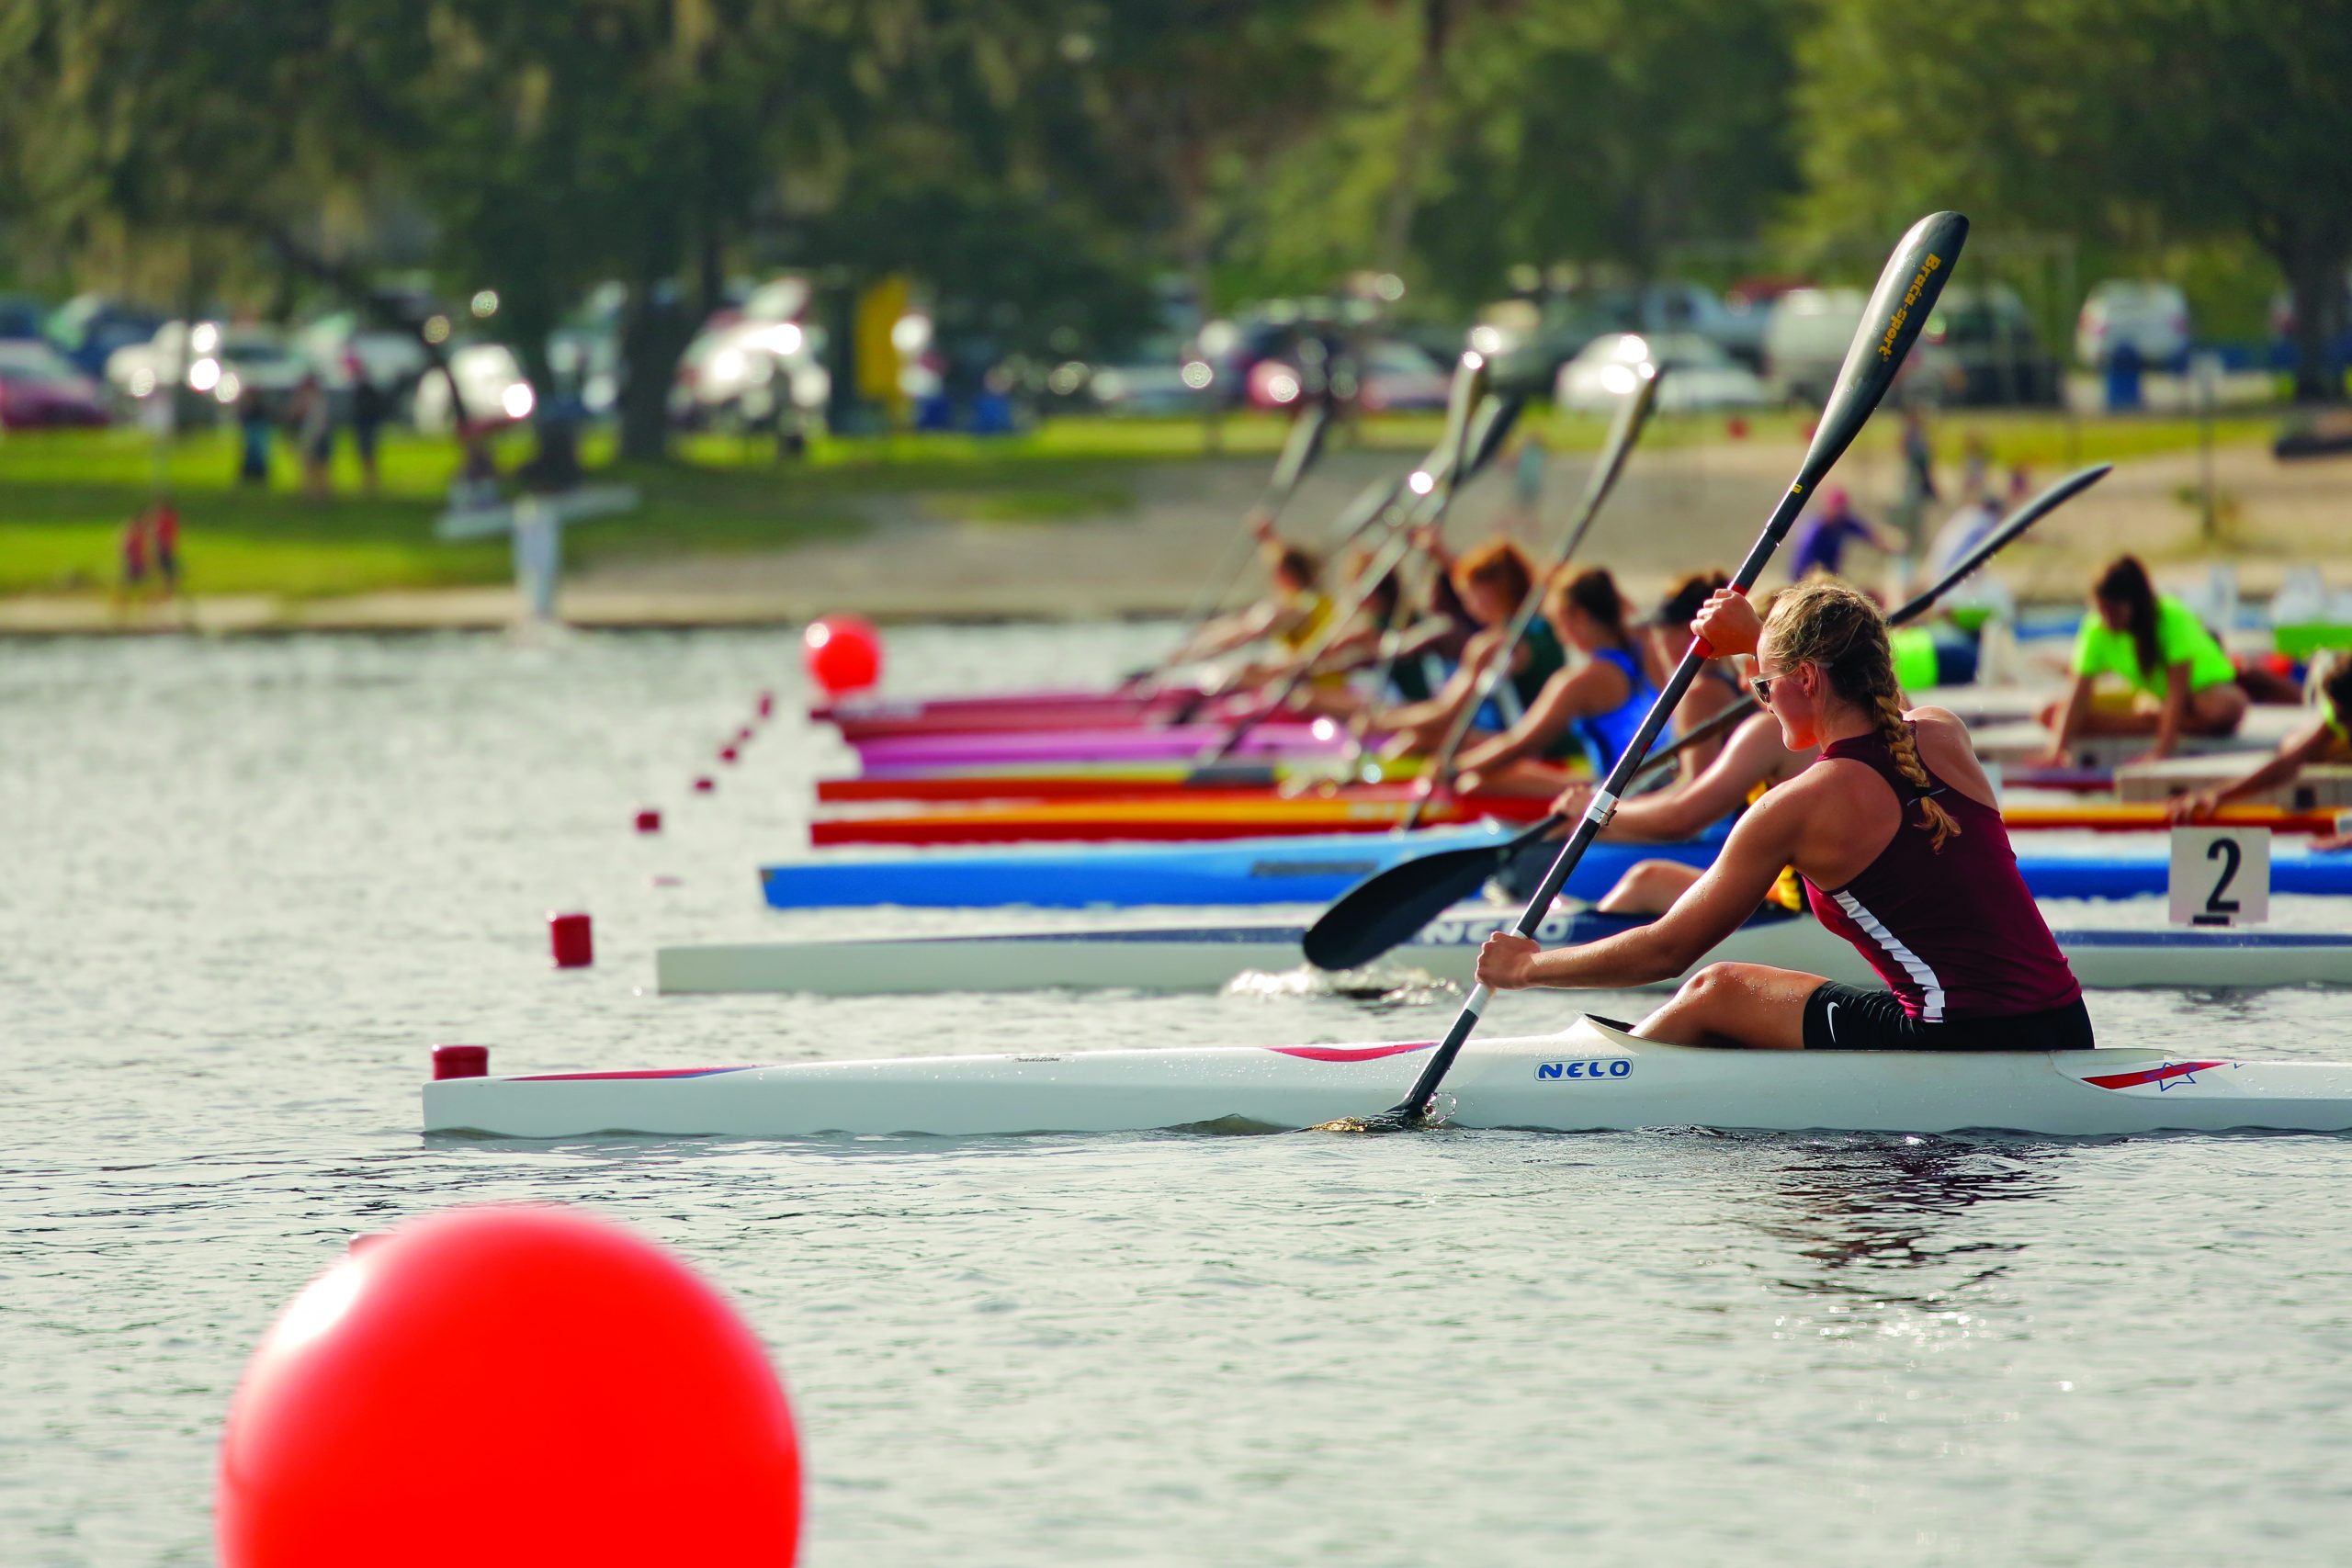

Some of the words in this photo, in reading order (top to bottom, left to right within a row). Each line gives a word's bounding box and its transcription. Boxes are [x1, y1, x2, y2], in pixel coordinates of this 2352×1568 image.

[2207, 837, 2241, 913] 2
[1422, 919, 1569, 943] NEO
[1538, 1060, 1631, 1078] NELO
